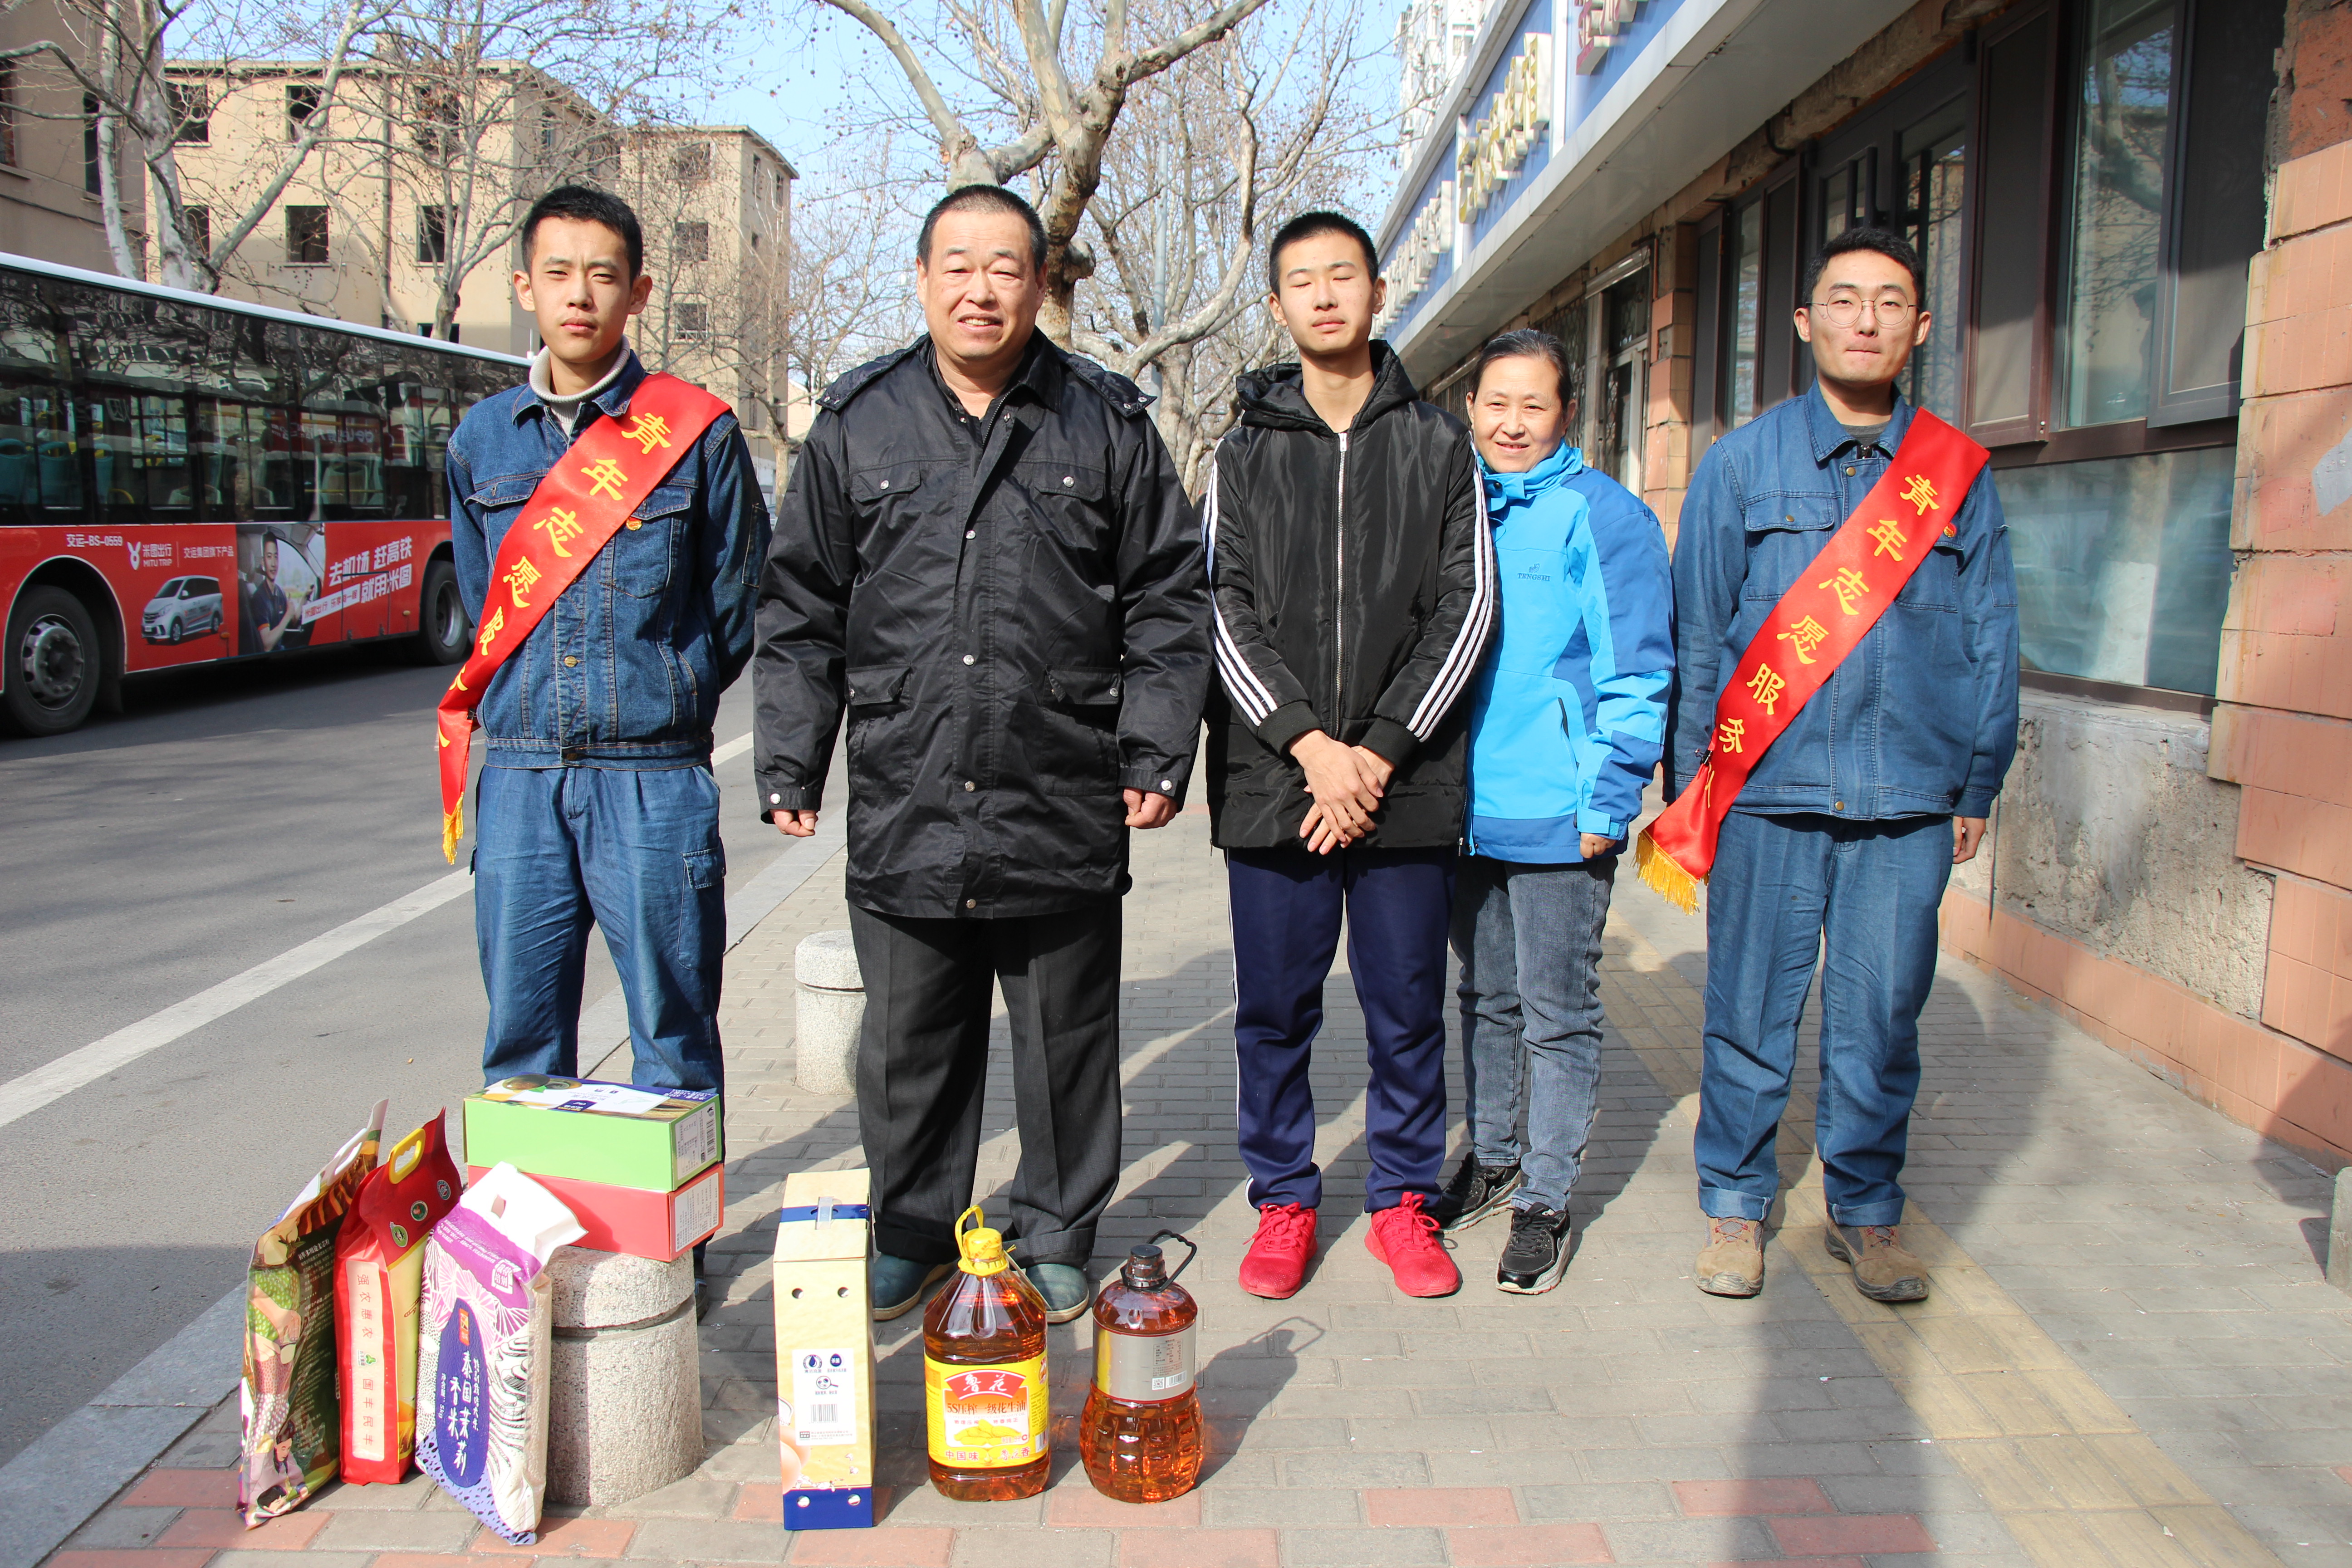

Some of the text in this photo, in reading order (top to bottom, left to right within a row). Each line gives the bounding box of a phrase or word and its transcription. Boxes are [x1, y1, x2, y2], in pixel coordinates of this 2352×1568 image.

[67, 534, 123, 547] 交运-BS-0559
[142, 544, 172, 558] 米图出行
[183, 546, 234, 559] 交运集团旗下产品
[143, 559, 172, 568] MITU TRIP
[329, 536, 412, 587] 去机场 赶高铁
[361, 564, 412, 603] 就用米图
[1517, 573, 1551, 582] TENGSHI
[357, 1274, 373, 1339] 强农惠农
[963, 1374, 1007, 1392] 鲁花
[454, 1350, 473, 1476] 泰国茉莉
[945, 1446, 1030, 1461] 中国味 鲁花香
